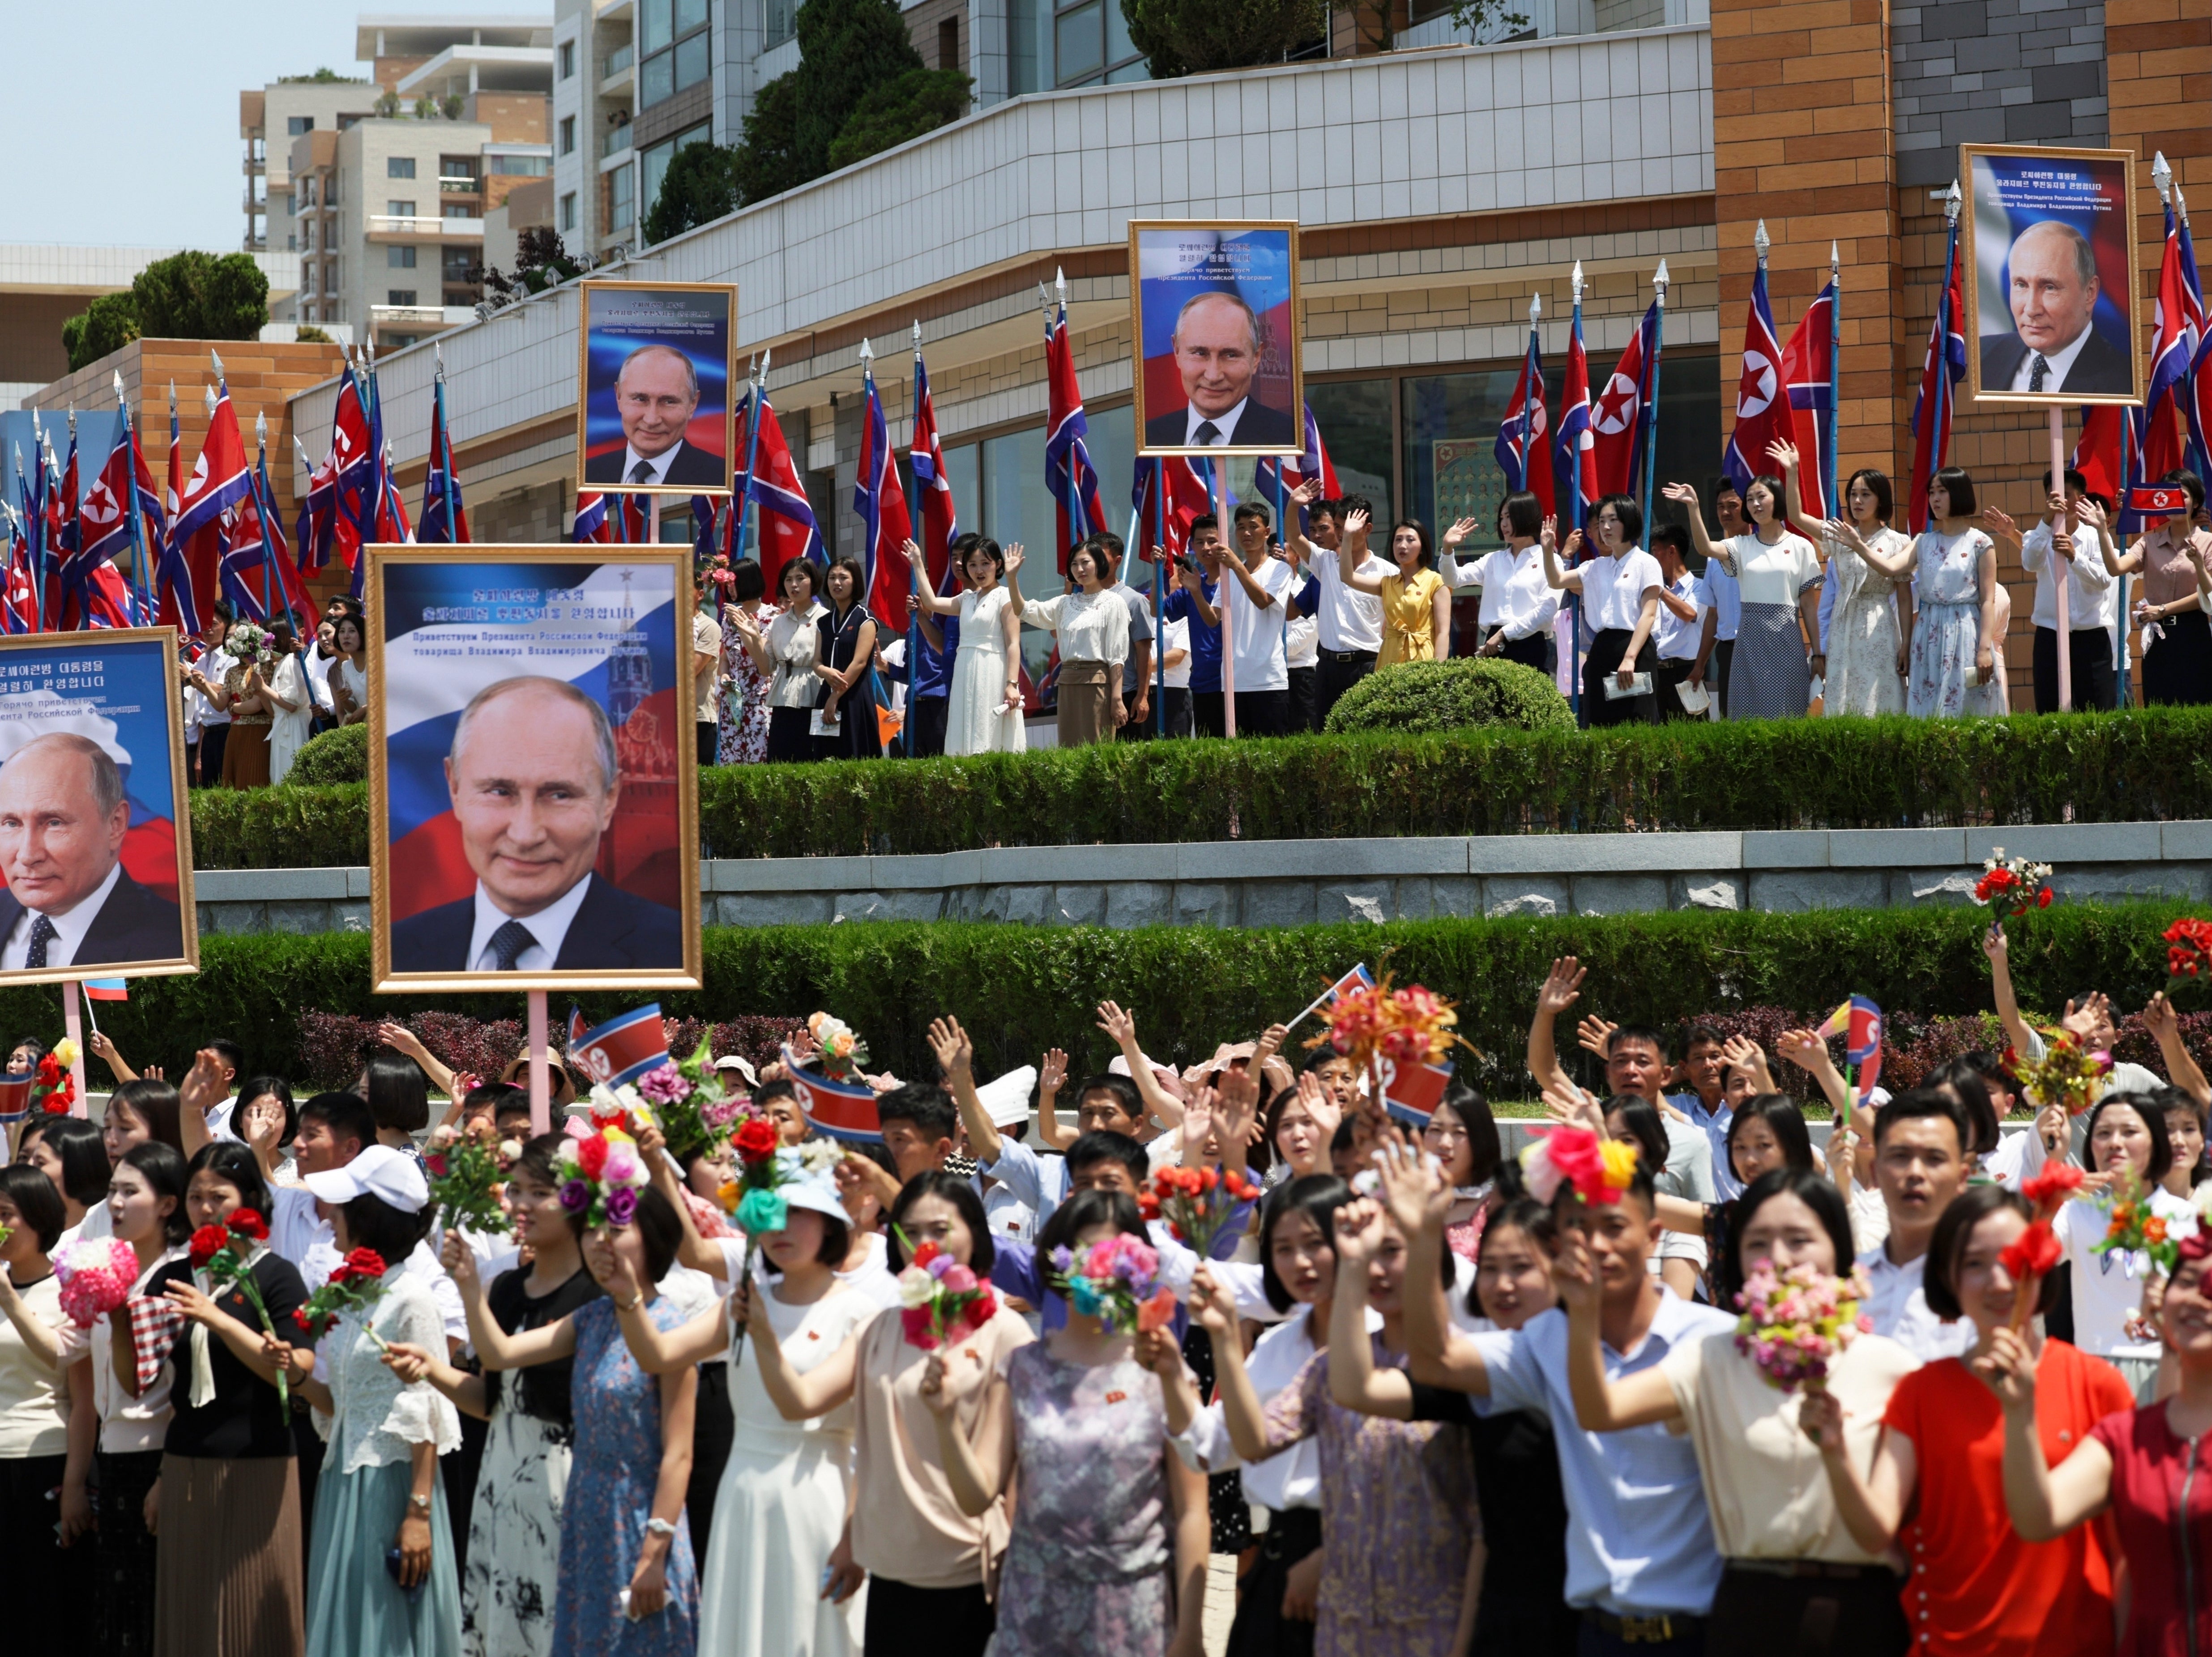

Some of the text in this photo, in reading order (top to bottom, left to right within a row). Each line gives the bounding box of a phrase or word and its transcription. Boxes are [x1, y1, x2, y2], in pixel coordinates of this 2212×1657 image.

[2070, 183, 2102, 191] 환영합니다
[413, 631, 648, 642] Приветствуем Президента Российской Федерации
[414, 648, 462, 656] товарища
[469, 647, 522, 656] Владимира
[529, 647, 605, 656] Владимировича
[60, 660, 103, 673] 대통령을
[43, 676, 104, 690] 환영합니다
[28, 708, 82, 719] Российской
[88, 705, 141, 716] Федерации
